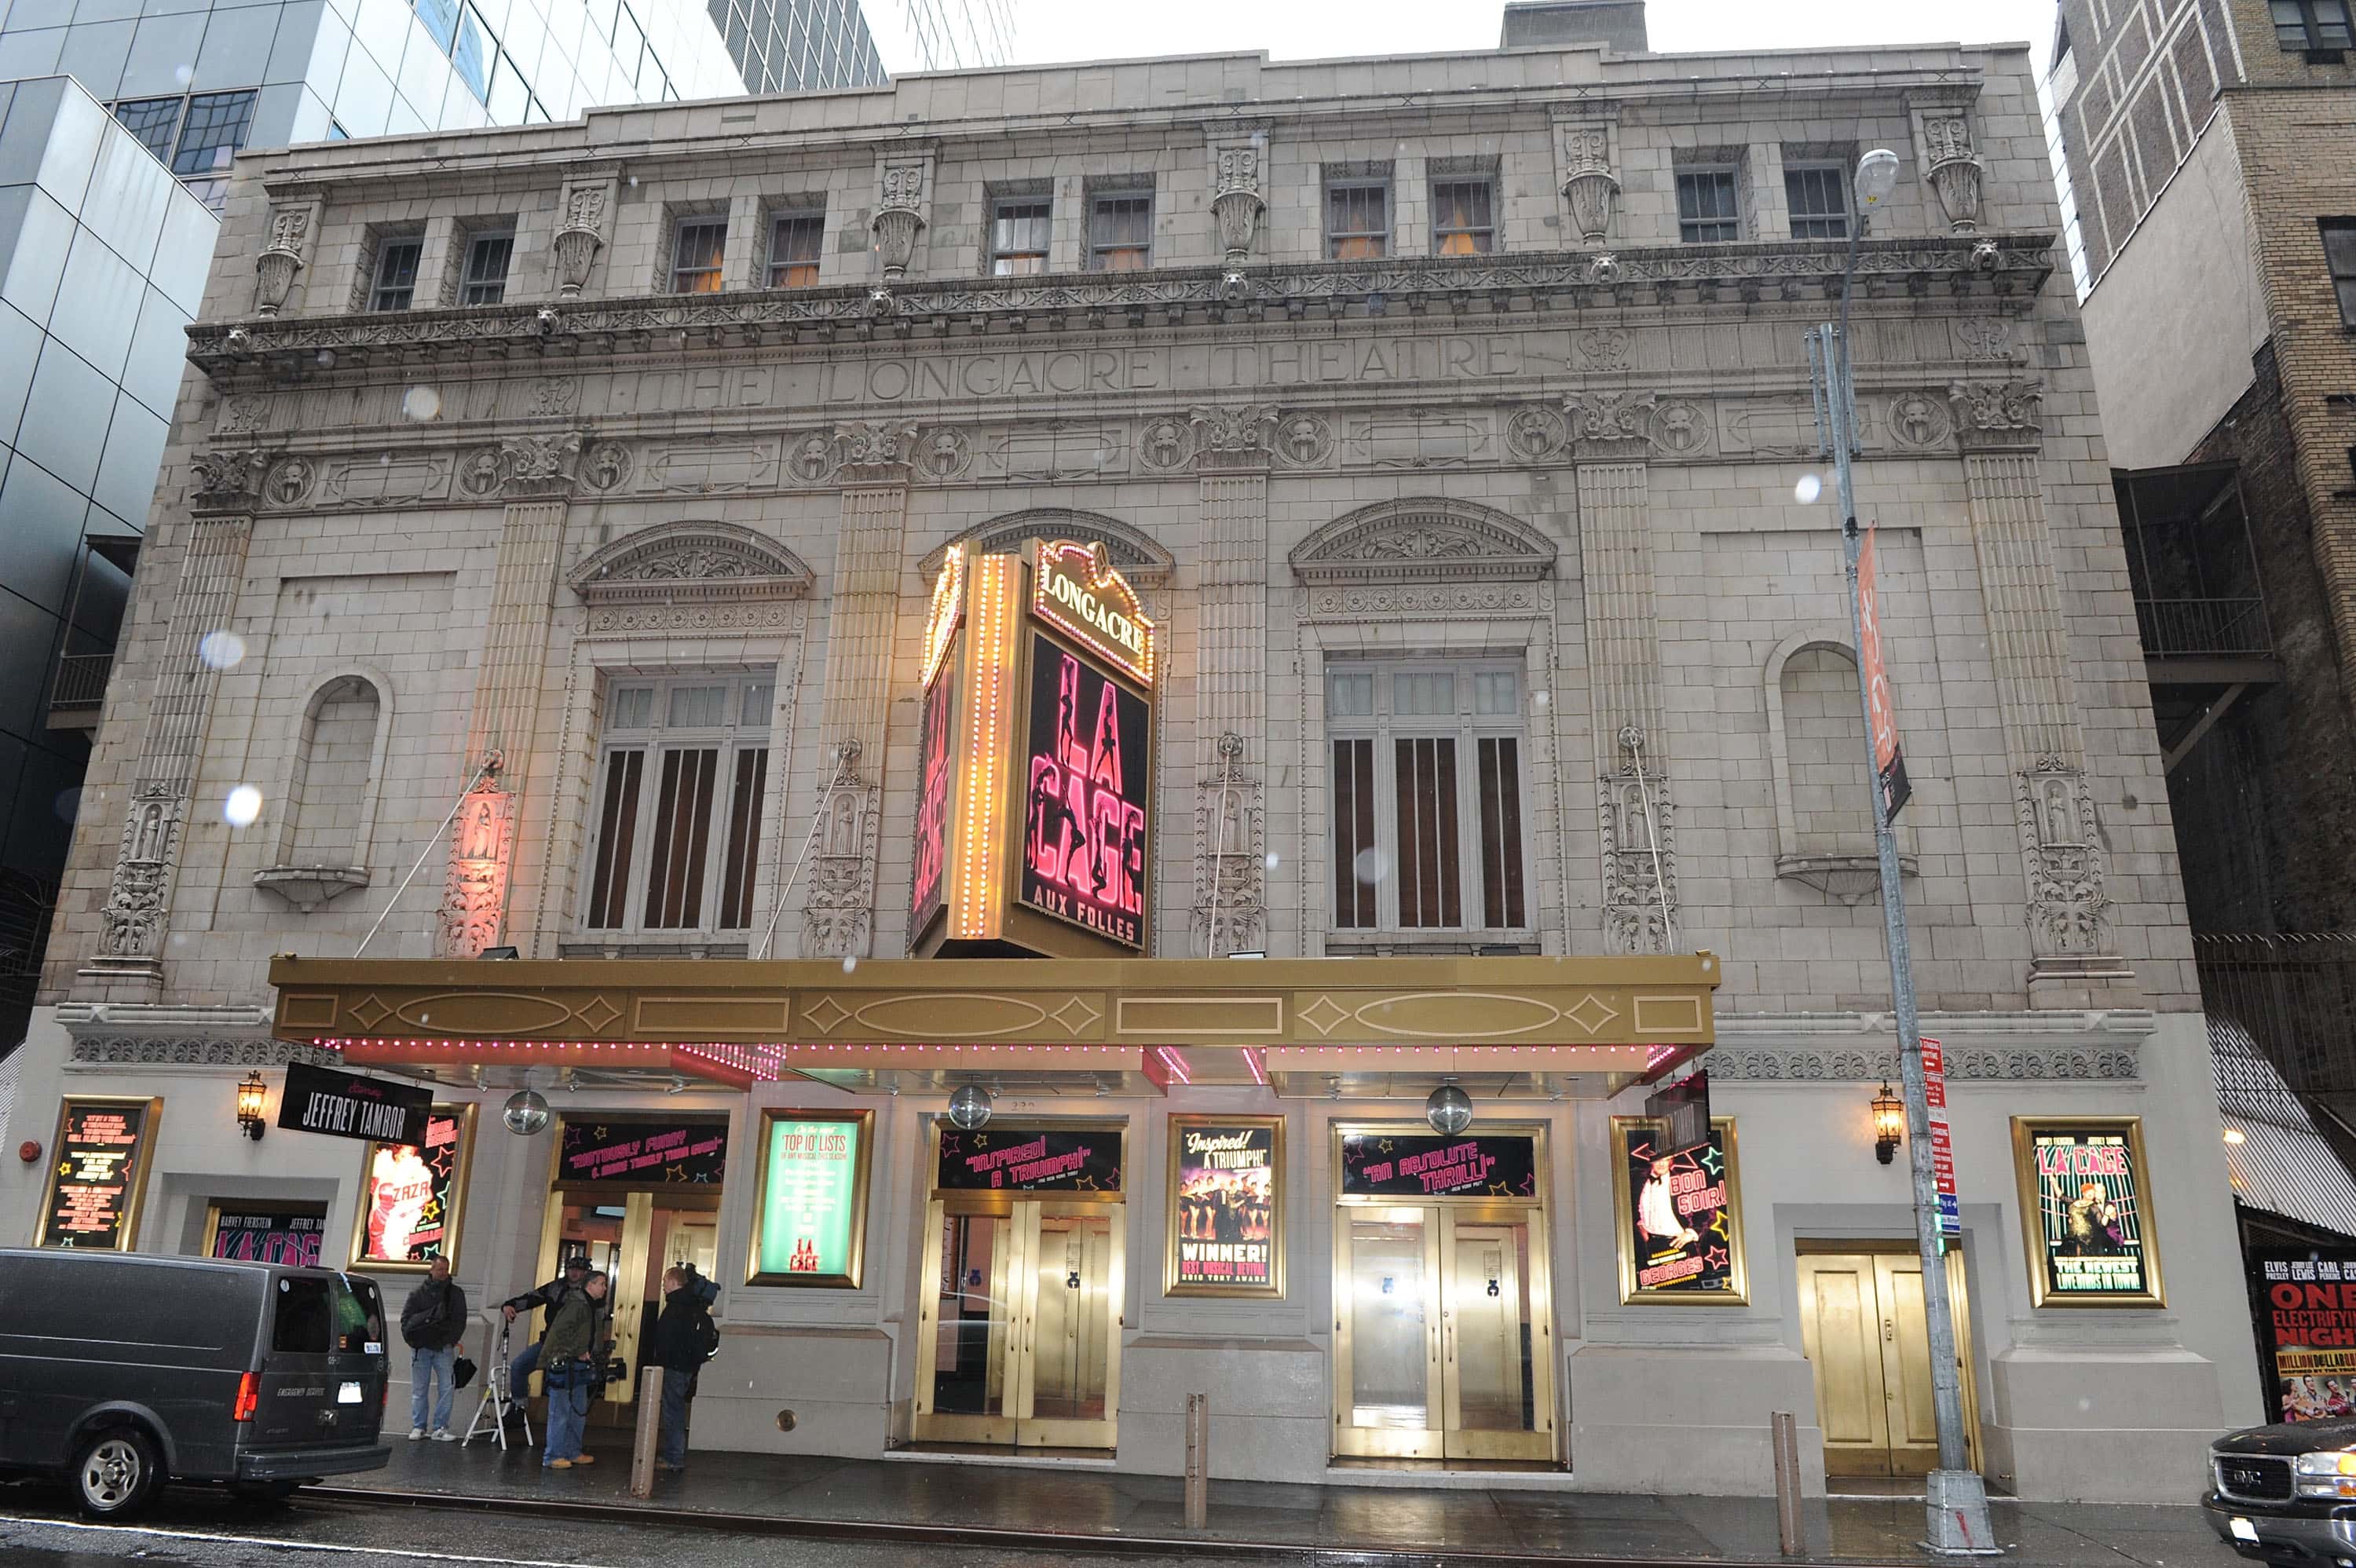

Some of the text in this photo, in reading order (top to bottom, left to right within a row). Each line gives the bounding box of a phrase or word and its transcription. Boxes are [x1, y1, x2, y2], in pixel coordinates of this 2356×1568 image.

[644, 337, 1519, 411] THE LONGACRE THEATRE
[1042, 564, 1145, 656] LONGACRE
[1057, 652, 1123, 795] LA
[1027, 755, 1144, 916] CAGE
[1033, 885, 1135, 942] AUX FOLLES
[302, 1091, 359, 1132] JEFFREY
[359, 1101, 406, 1139] TAMBOR
[818, 1135, 846, 1152] LISTS
[1203, 1150, 1212, 1170] A
[1399, 1142, 1477, 1176] ABSOLUTE
[2037, 1146, 2129, 1175] LA CAGE
[991, 1170, 1002, 1188] A
[1670, 1169, 1707, 1197] BON
[393, 1180, 430, 1203] ZAZA
[1677, 1179, 1728, 1215] SOIR!
[220, 1216, 242, 1227] HARVEY
[243, 1216, 273, 1229] FIERSTEIN
[289, 1218, 315, 1230] JEFFREY
[796, 1238, 813, 1255] LA
[1182, 1243, 1268, 1263] WINNER!
[789, 1254, 818, 1272] CAGE
[1182, 1261, 1266, 1276] BEST MUSICAL REVIVAL
[1639, 1256, 1704, 1286] GEORGES
[2054, 1261, 2138, 1274] THE NEWEST
[2263, 1261, 2288, 1273] ELVIS
[2318, 1261, 2340, 1273] CARL
[2292, 1269, 2316, 1281] LEWIS
